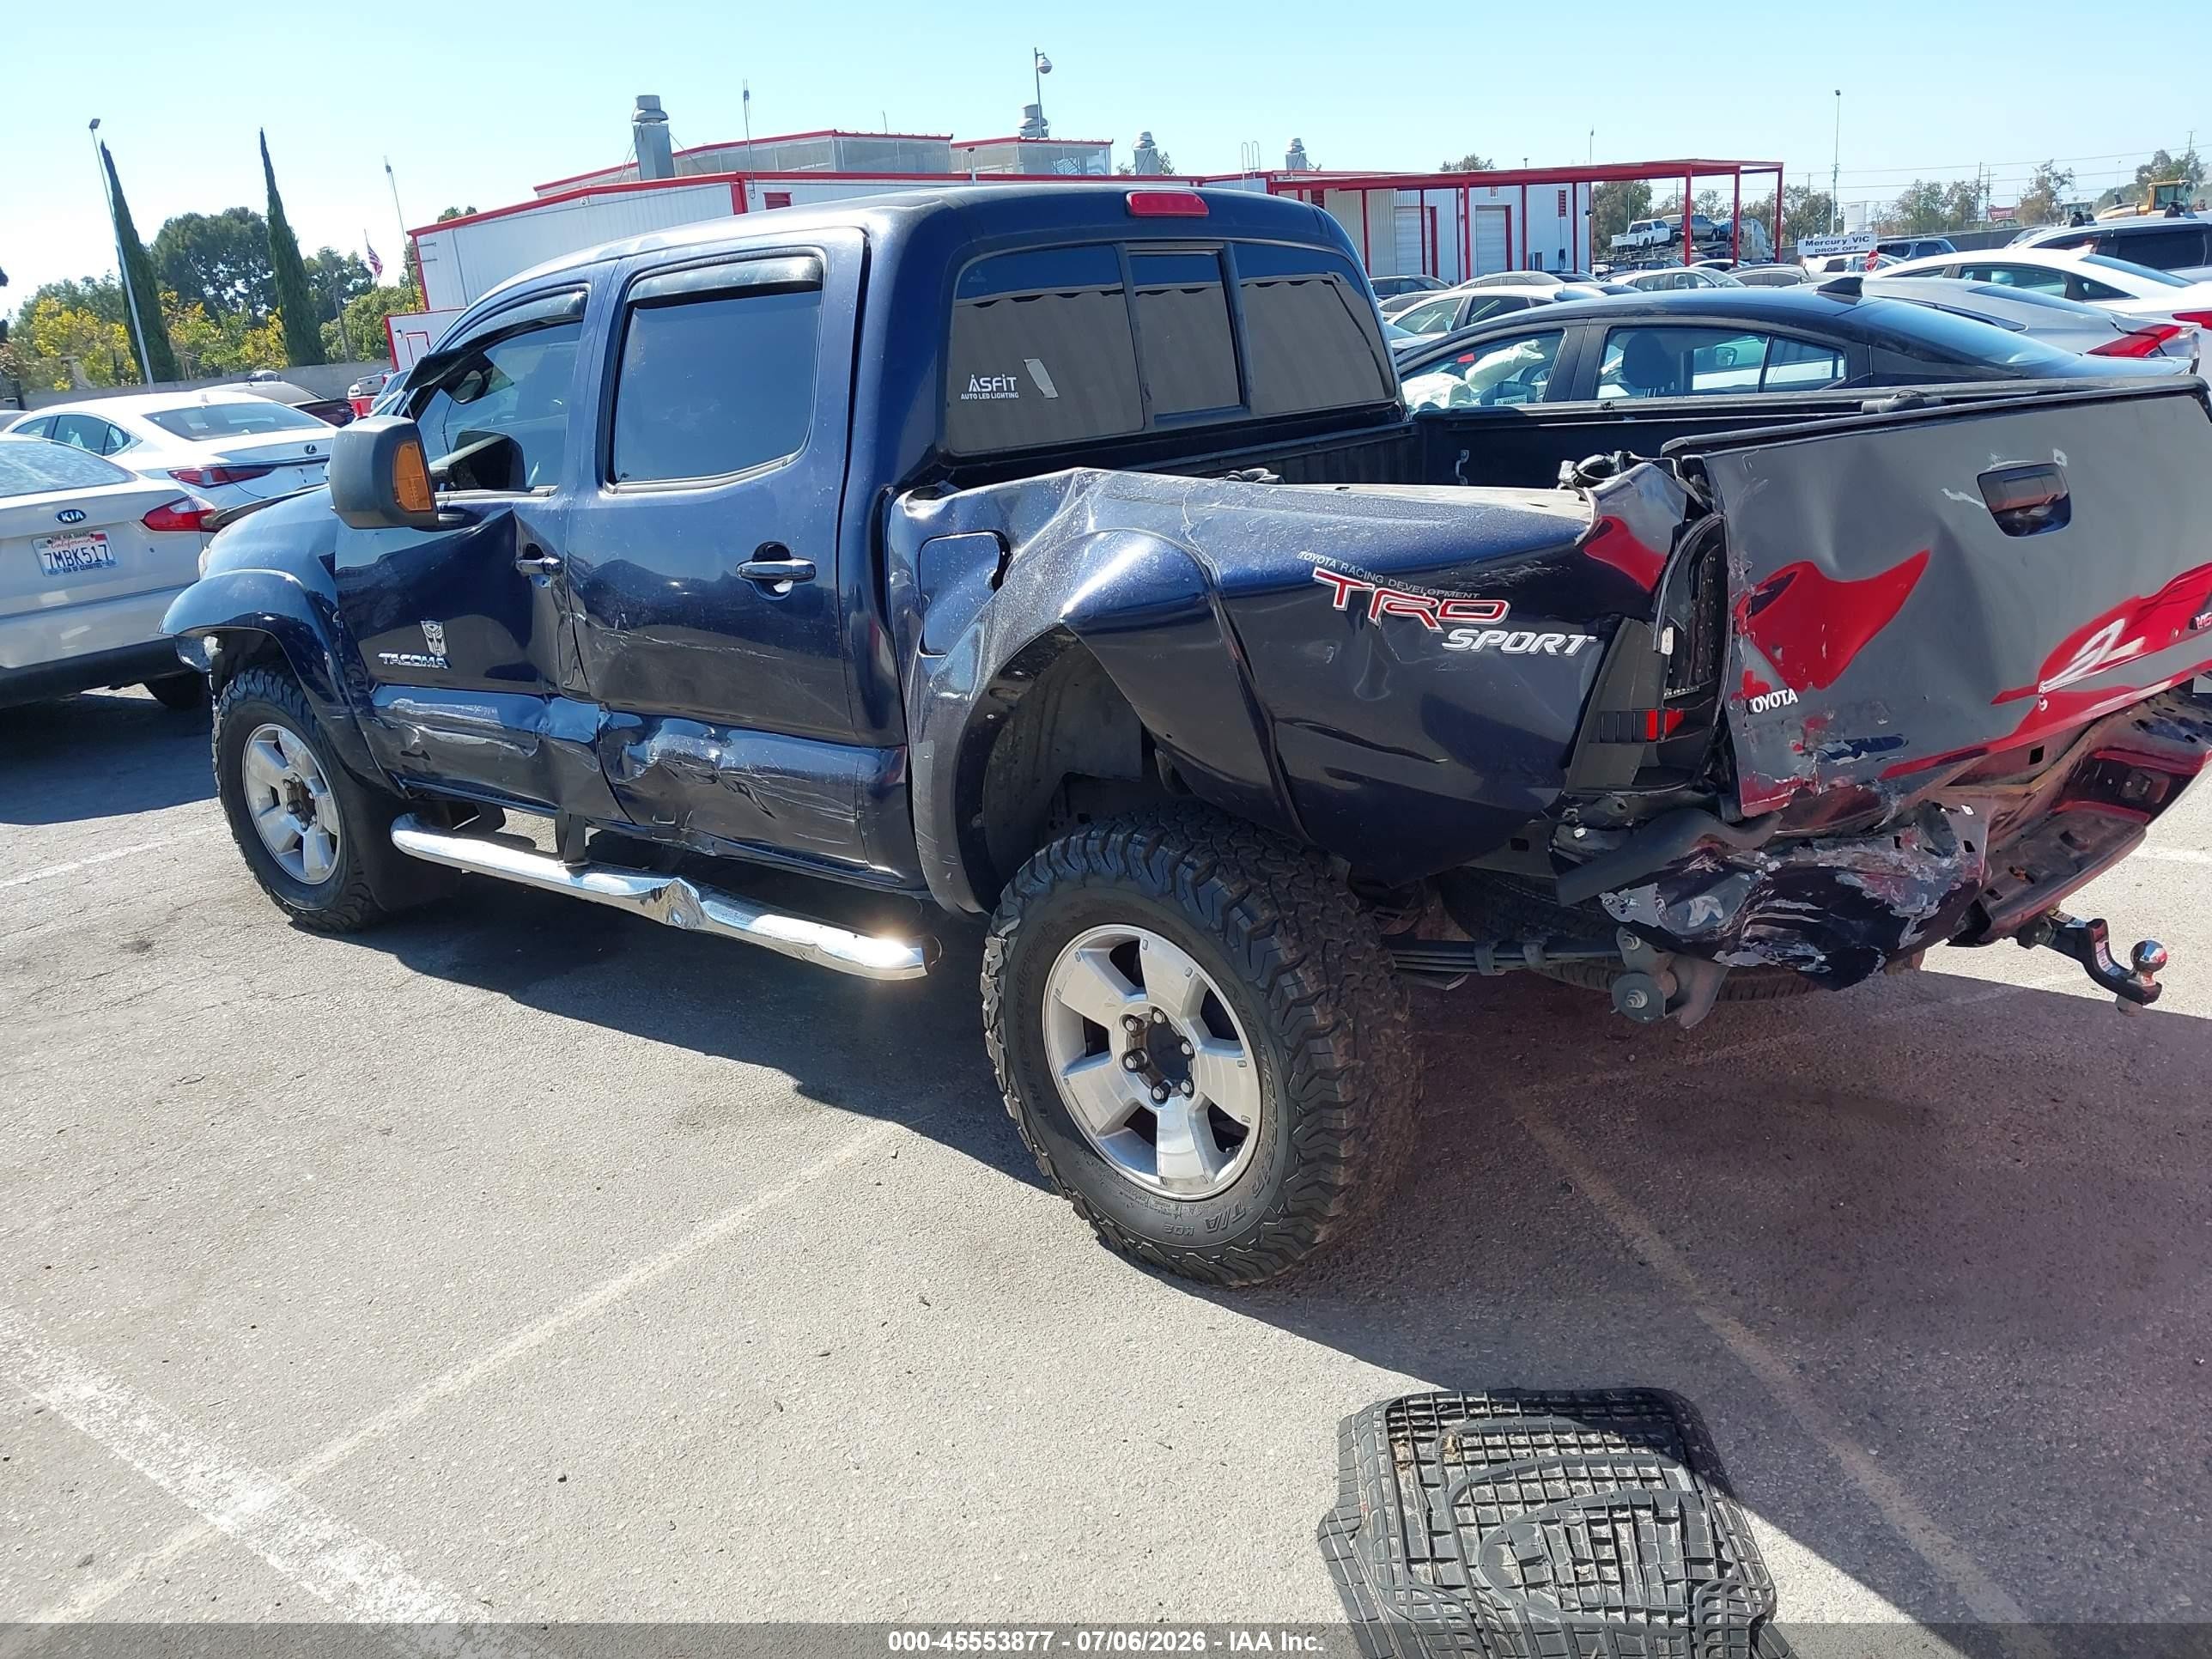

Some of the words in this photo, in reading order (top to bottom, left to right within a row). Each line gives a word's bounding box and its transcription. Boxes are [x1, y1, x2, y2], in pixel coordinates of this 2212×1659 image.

[1805, 238, 1847, 246] Mercury
[1851, 235, 1870, 244] VIC
[60, 510, 84, 522] KIA
[43, 544, 109, 569] 7MBK517
[1297, 550, 1337, 568] TOYOTA
[1340, 562, 1385, 585] RACING
[1388, 578, 1481, 599] DEVELOPMENT
[1311, 566, 1511, 633] TRD
[1442, 628, 1599, 656] SPORT
[378, 652, 448, 670] TACOMA
